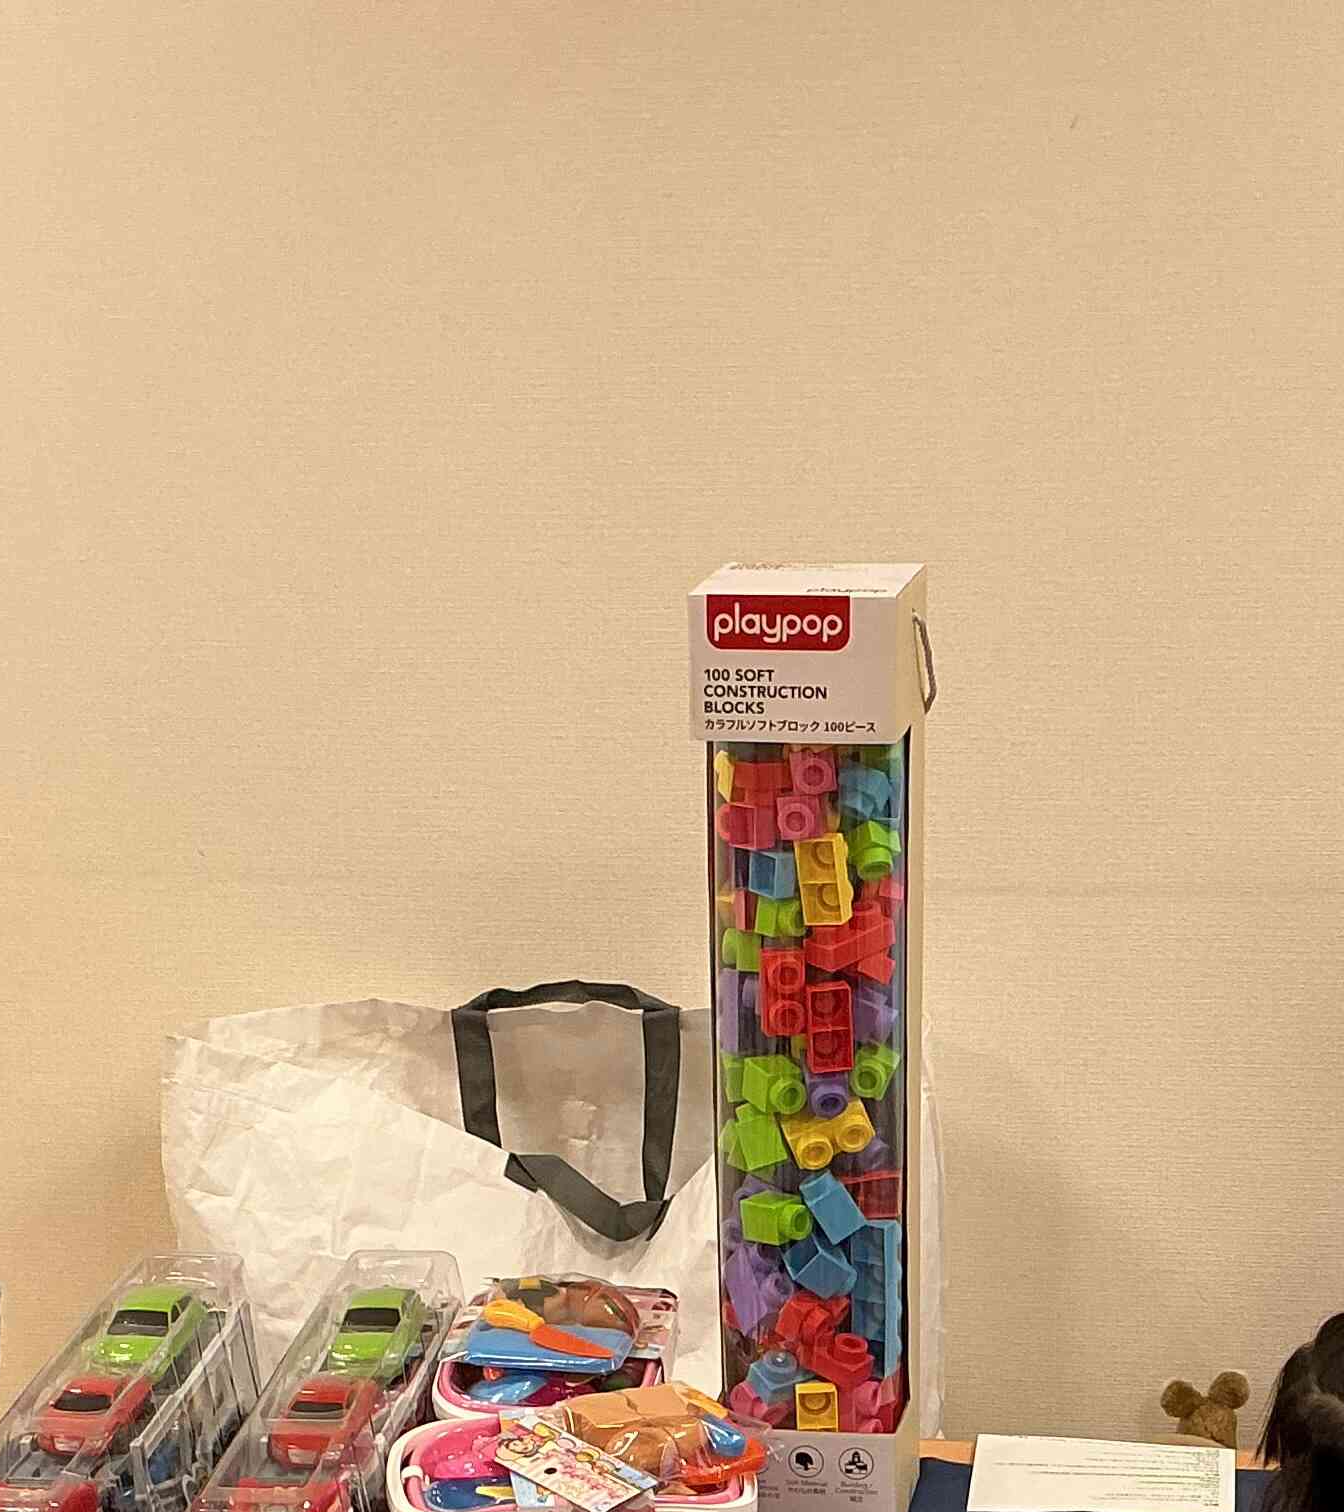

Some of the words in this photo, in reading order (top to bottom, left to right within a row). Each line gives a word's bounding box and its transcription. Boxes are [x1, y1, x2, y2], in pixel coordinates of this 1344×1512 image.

[713, 602, 843, 643] playpop
[704, 669, 731, 682] 100
[735, 669, 775, 682] SOFT
[703, 685, 828, 700] CONSTRUCTION
[704, 701, 765, 715] BLOCKS
[704, 719, 820, 733] カラフルソフトブロック
[823, 721, 876, 733] 100ピース
